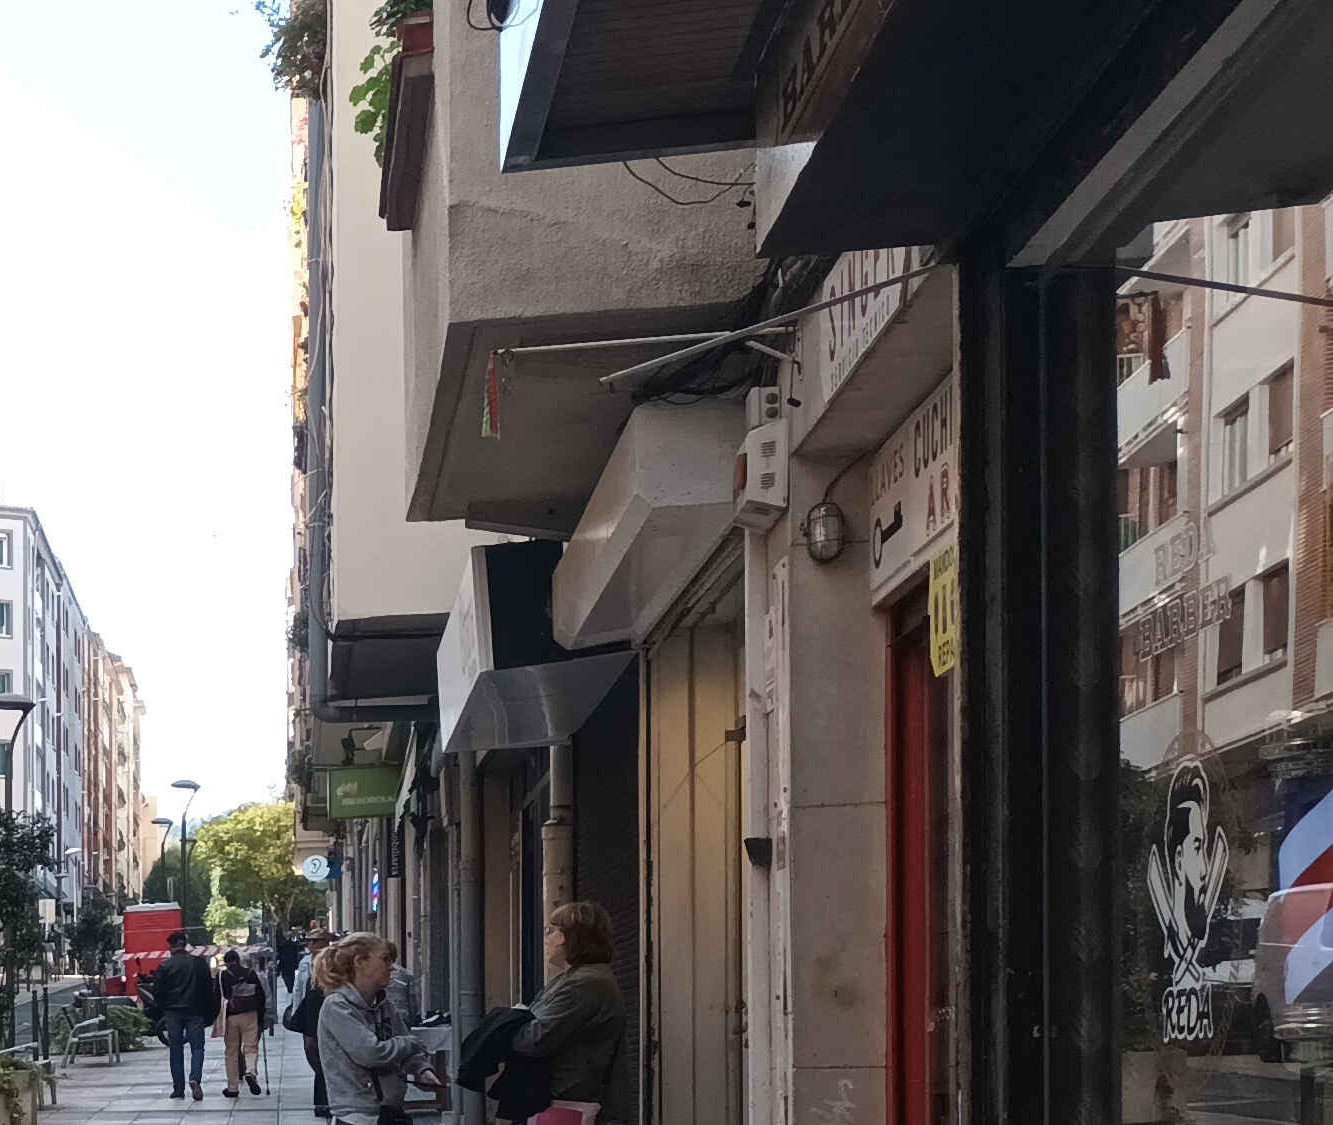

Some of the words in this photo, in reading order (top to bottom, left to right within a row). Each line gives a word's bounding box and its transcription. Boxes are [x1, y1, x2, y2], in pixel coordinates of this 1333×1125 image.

[914, 384, 953, 479] CUCHI
[925, 461, 951, 537] AR
[1153, 514, 1217, 587] REDA
[1139, 573, 1233, 663] BARBER
[1162, 982, 1214, 1043] REDA
